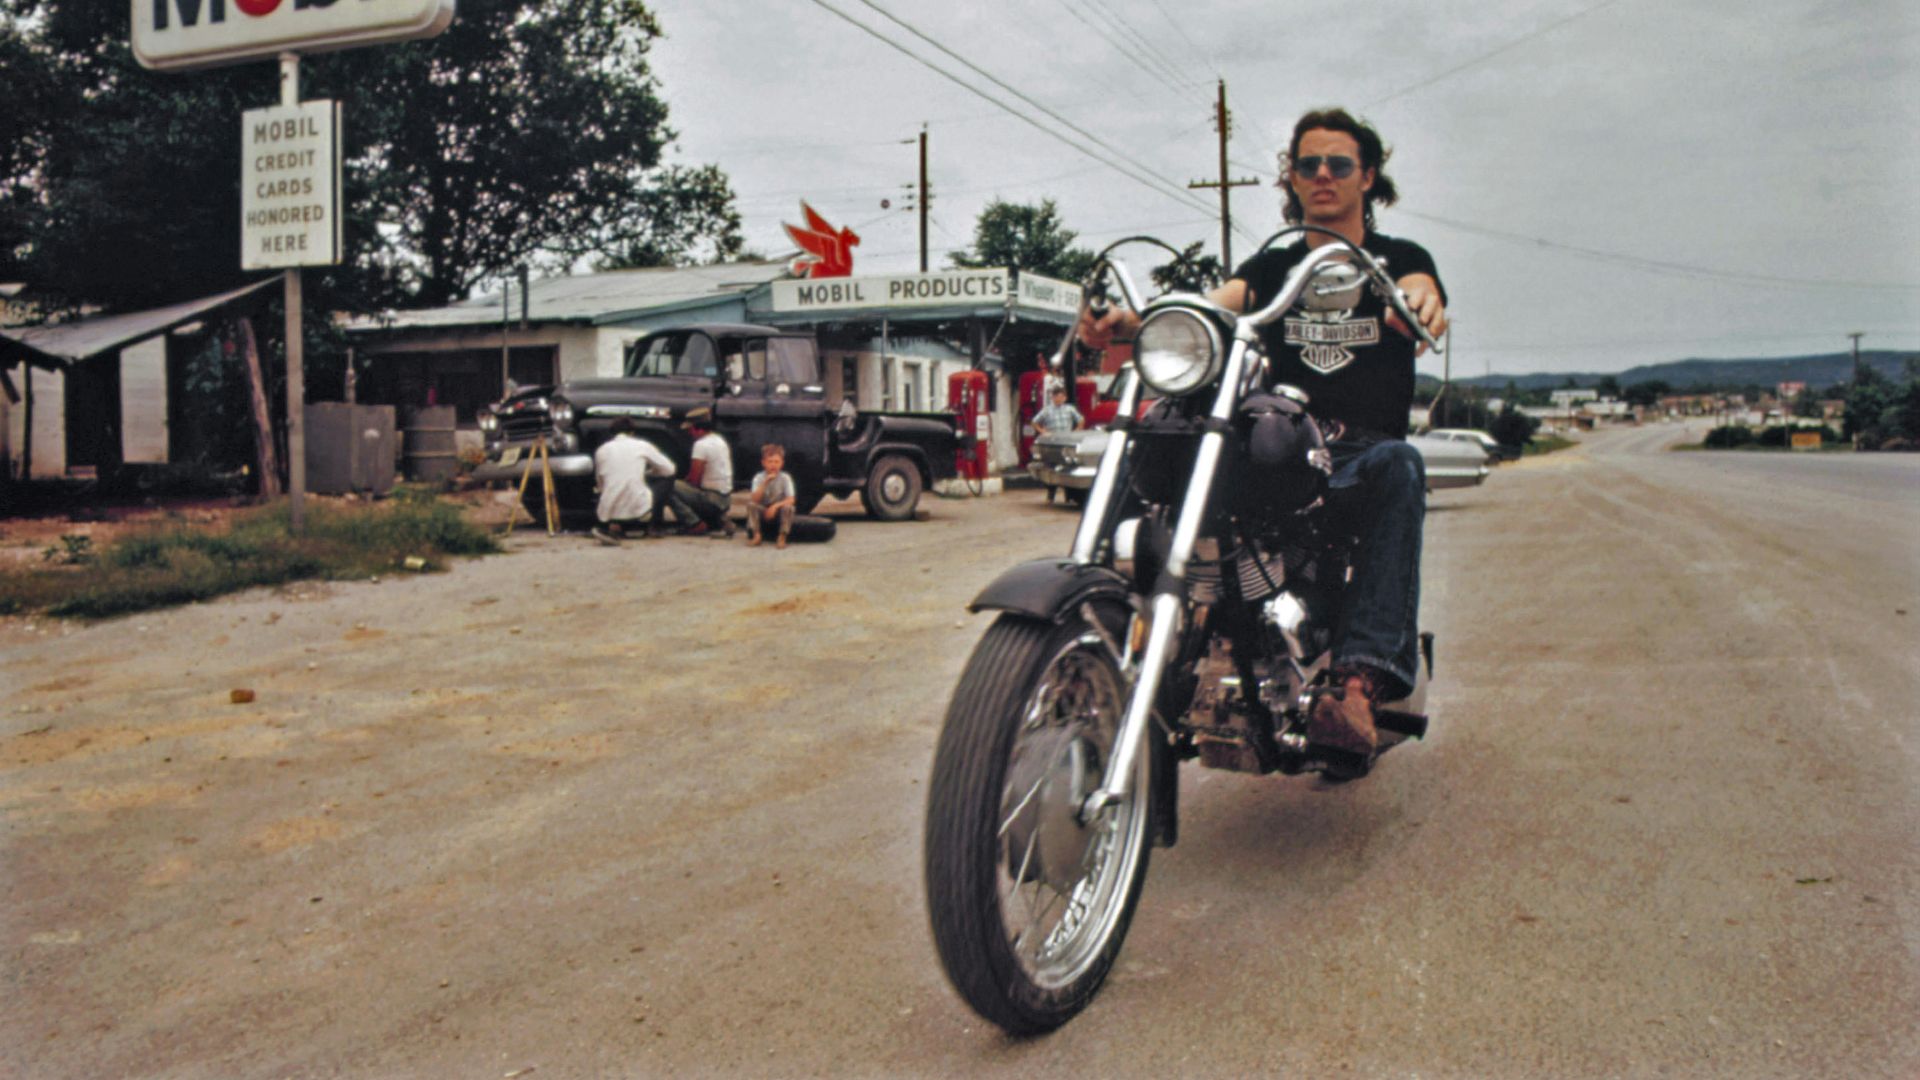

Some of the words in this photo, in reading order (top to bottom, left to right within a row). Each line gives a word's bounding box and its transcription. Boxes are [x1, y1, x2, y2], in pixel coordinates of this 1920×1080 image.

[253, 117, 319, 144] MOBIL
[255, 150, 315, 172] CREDIT
[256, 178, 313, 199] CARDS
[247, 204, 324, 226] HONORED
[261, 234, 308, 252] HERE
[798, 282, 864, 305] MOBIL
[889, 276, 1002, 299] PRODUCTS
